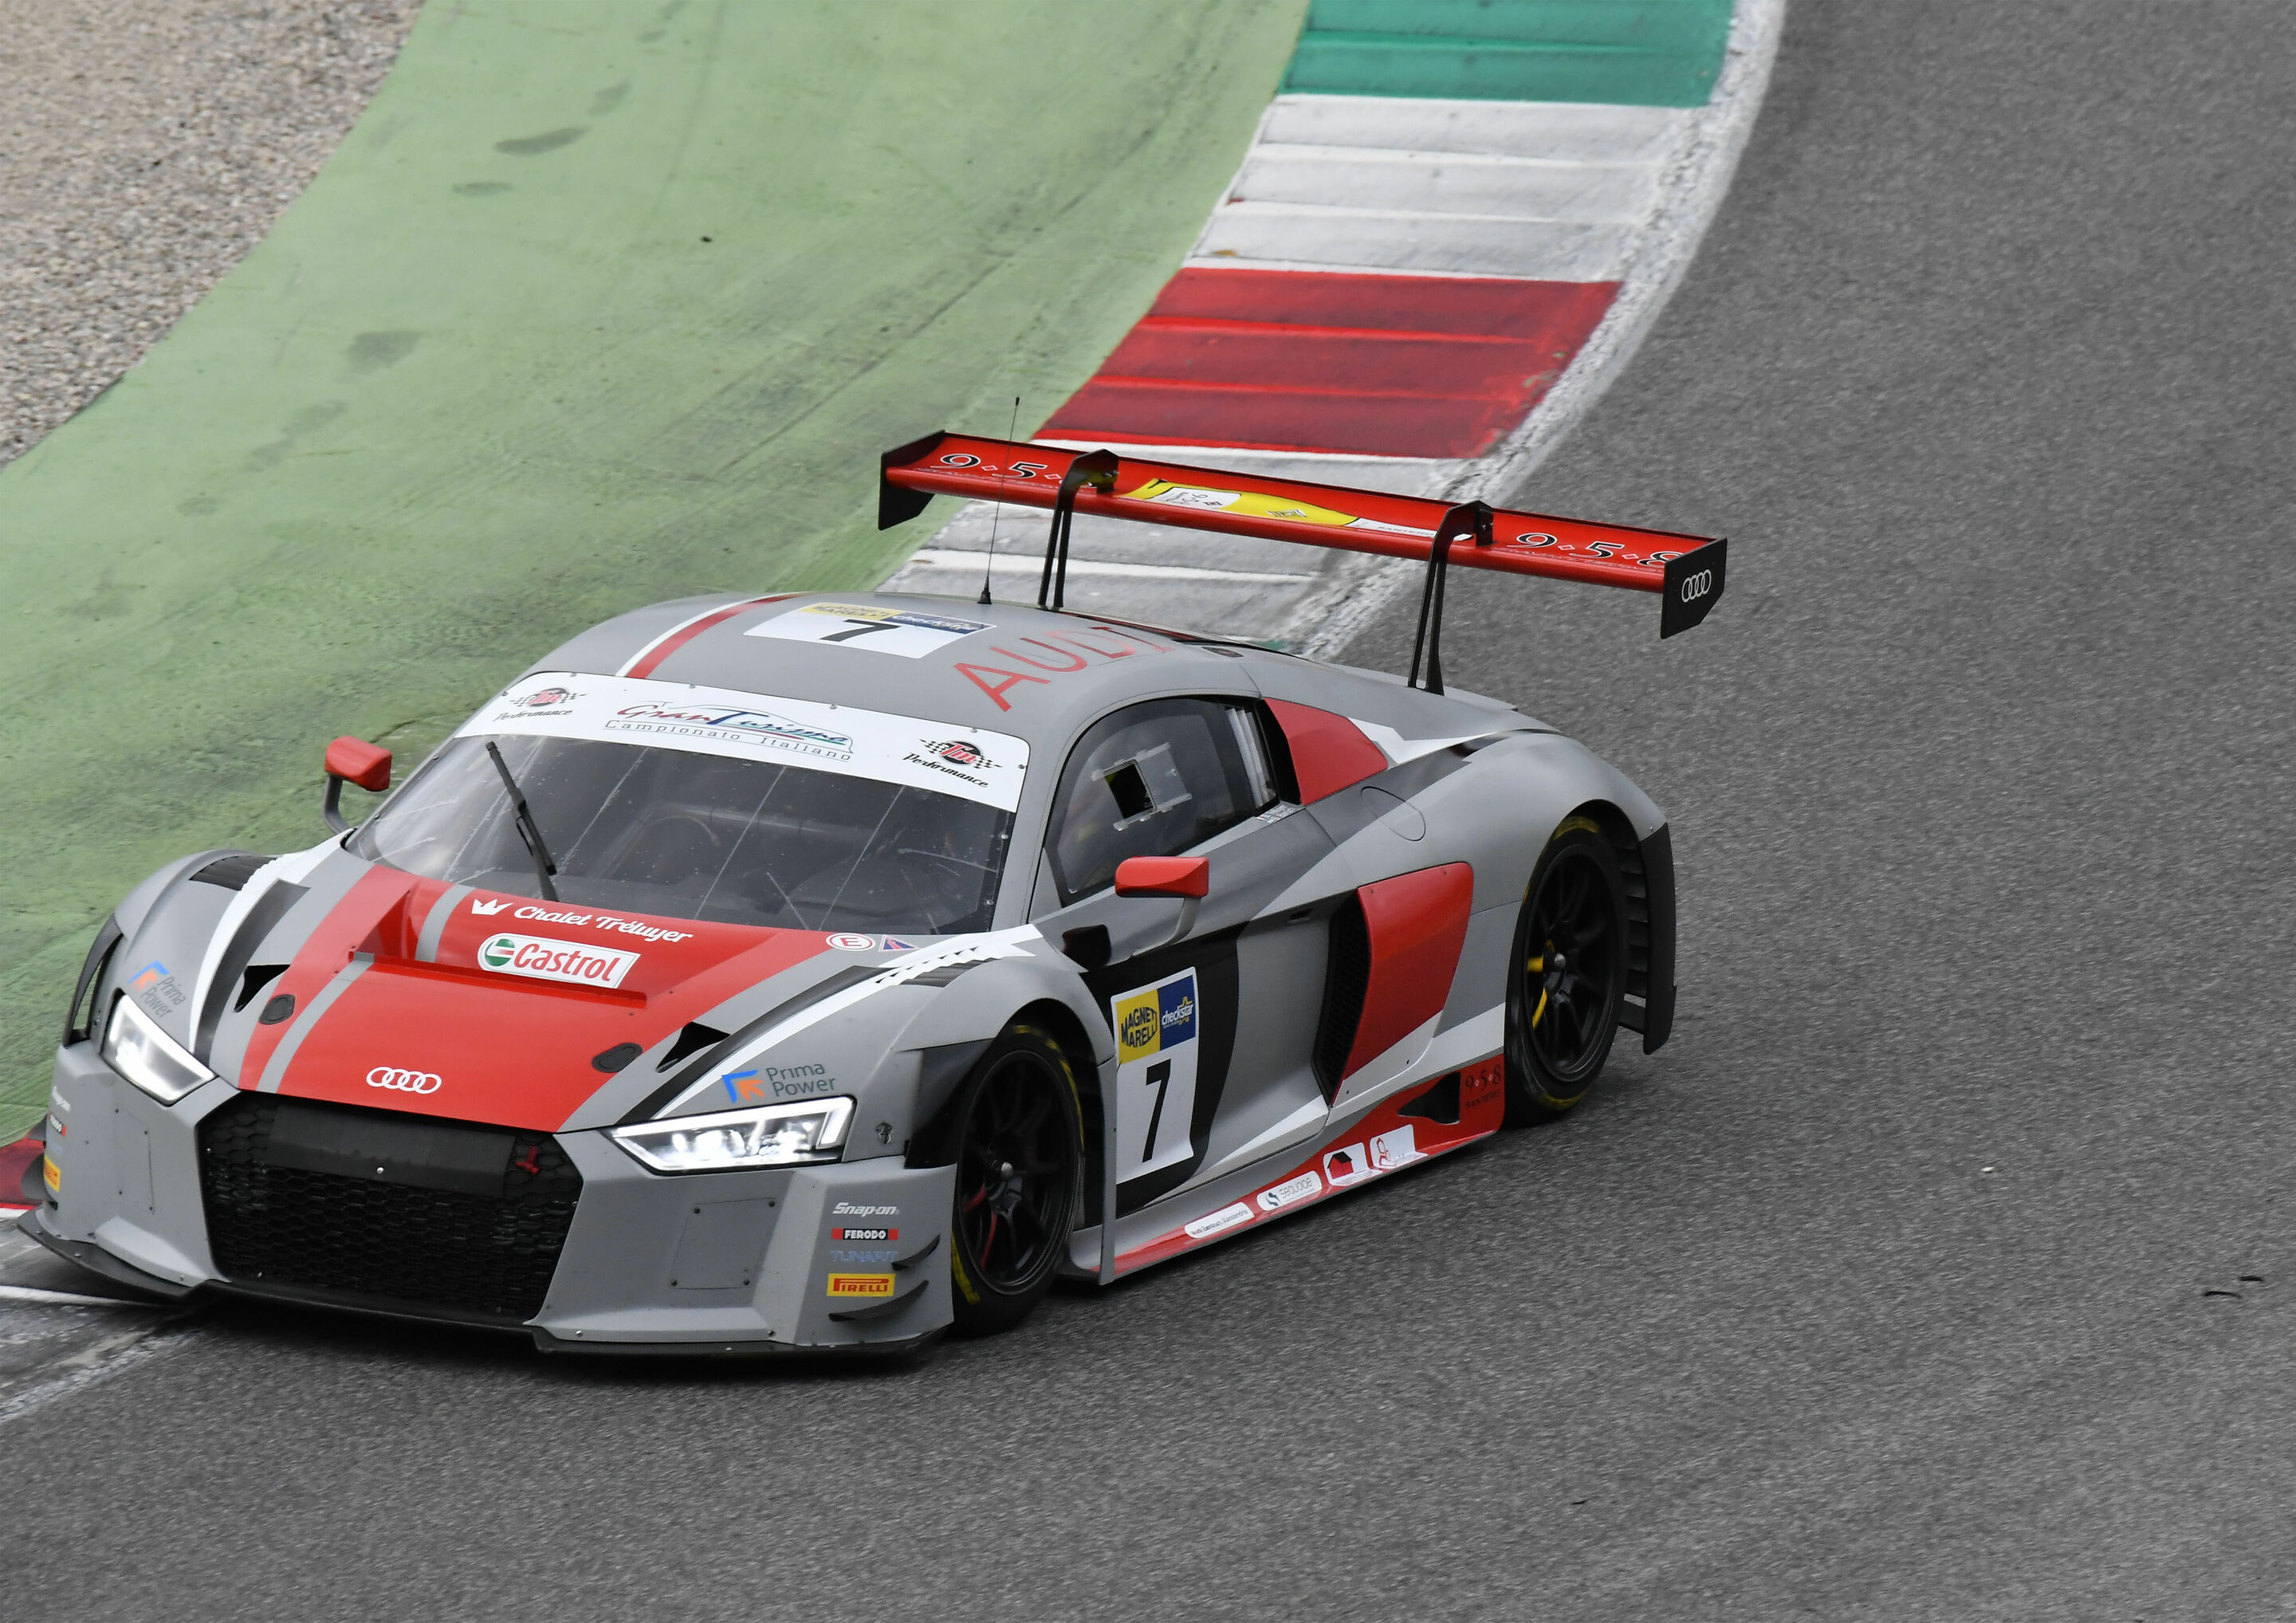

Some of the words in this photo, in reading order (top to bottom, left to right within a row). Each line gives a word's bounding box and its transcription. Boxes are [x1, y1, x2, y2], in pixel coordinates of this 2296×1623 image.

[819, 619, 902, 643] 7
[953, 626, 1177, 713] AUDI
[604, 719, 741, 741] Campionato
[760, 737, 851, 760] Italiano
[902, 752, 989, 788] Performance
[513, 906, 592, 925] Chalet
[596, 916, 694, 943] Tréluyer
[514, 943, 621, 982] Castrol
[140, 986, 172, 1018] Power
[157, 977, 187, 1005] Prima
[1162, 1003, 1193, 1026] checkstar
[766, 1063, 826, 1081] Prima
[772, 1078, 835, 1097] Power
[1142, 1058, 1172, 1164] 7
[843, 1229, 887, 1240] FERODO
[833, 1278, 890, 1292] PIRELLI
